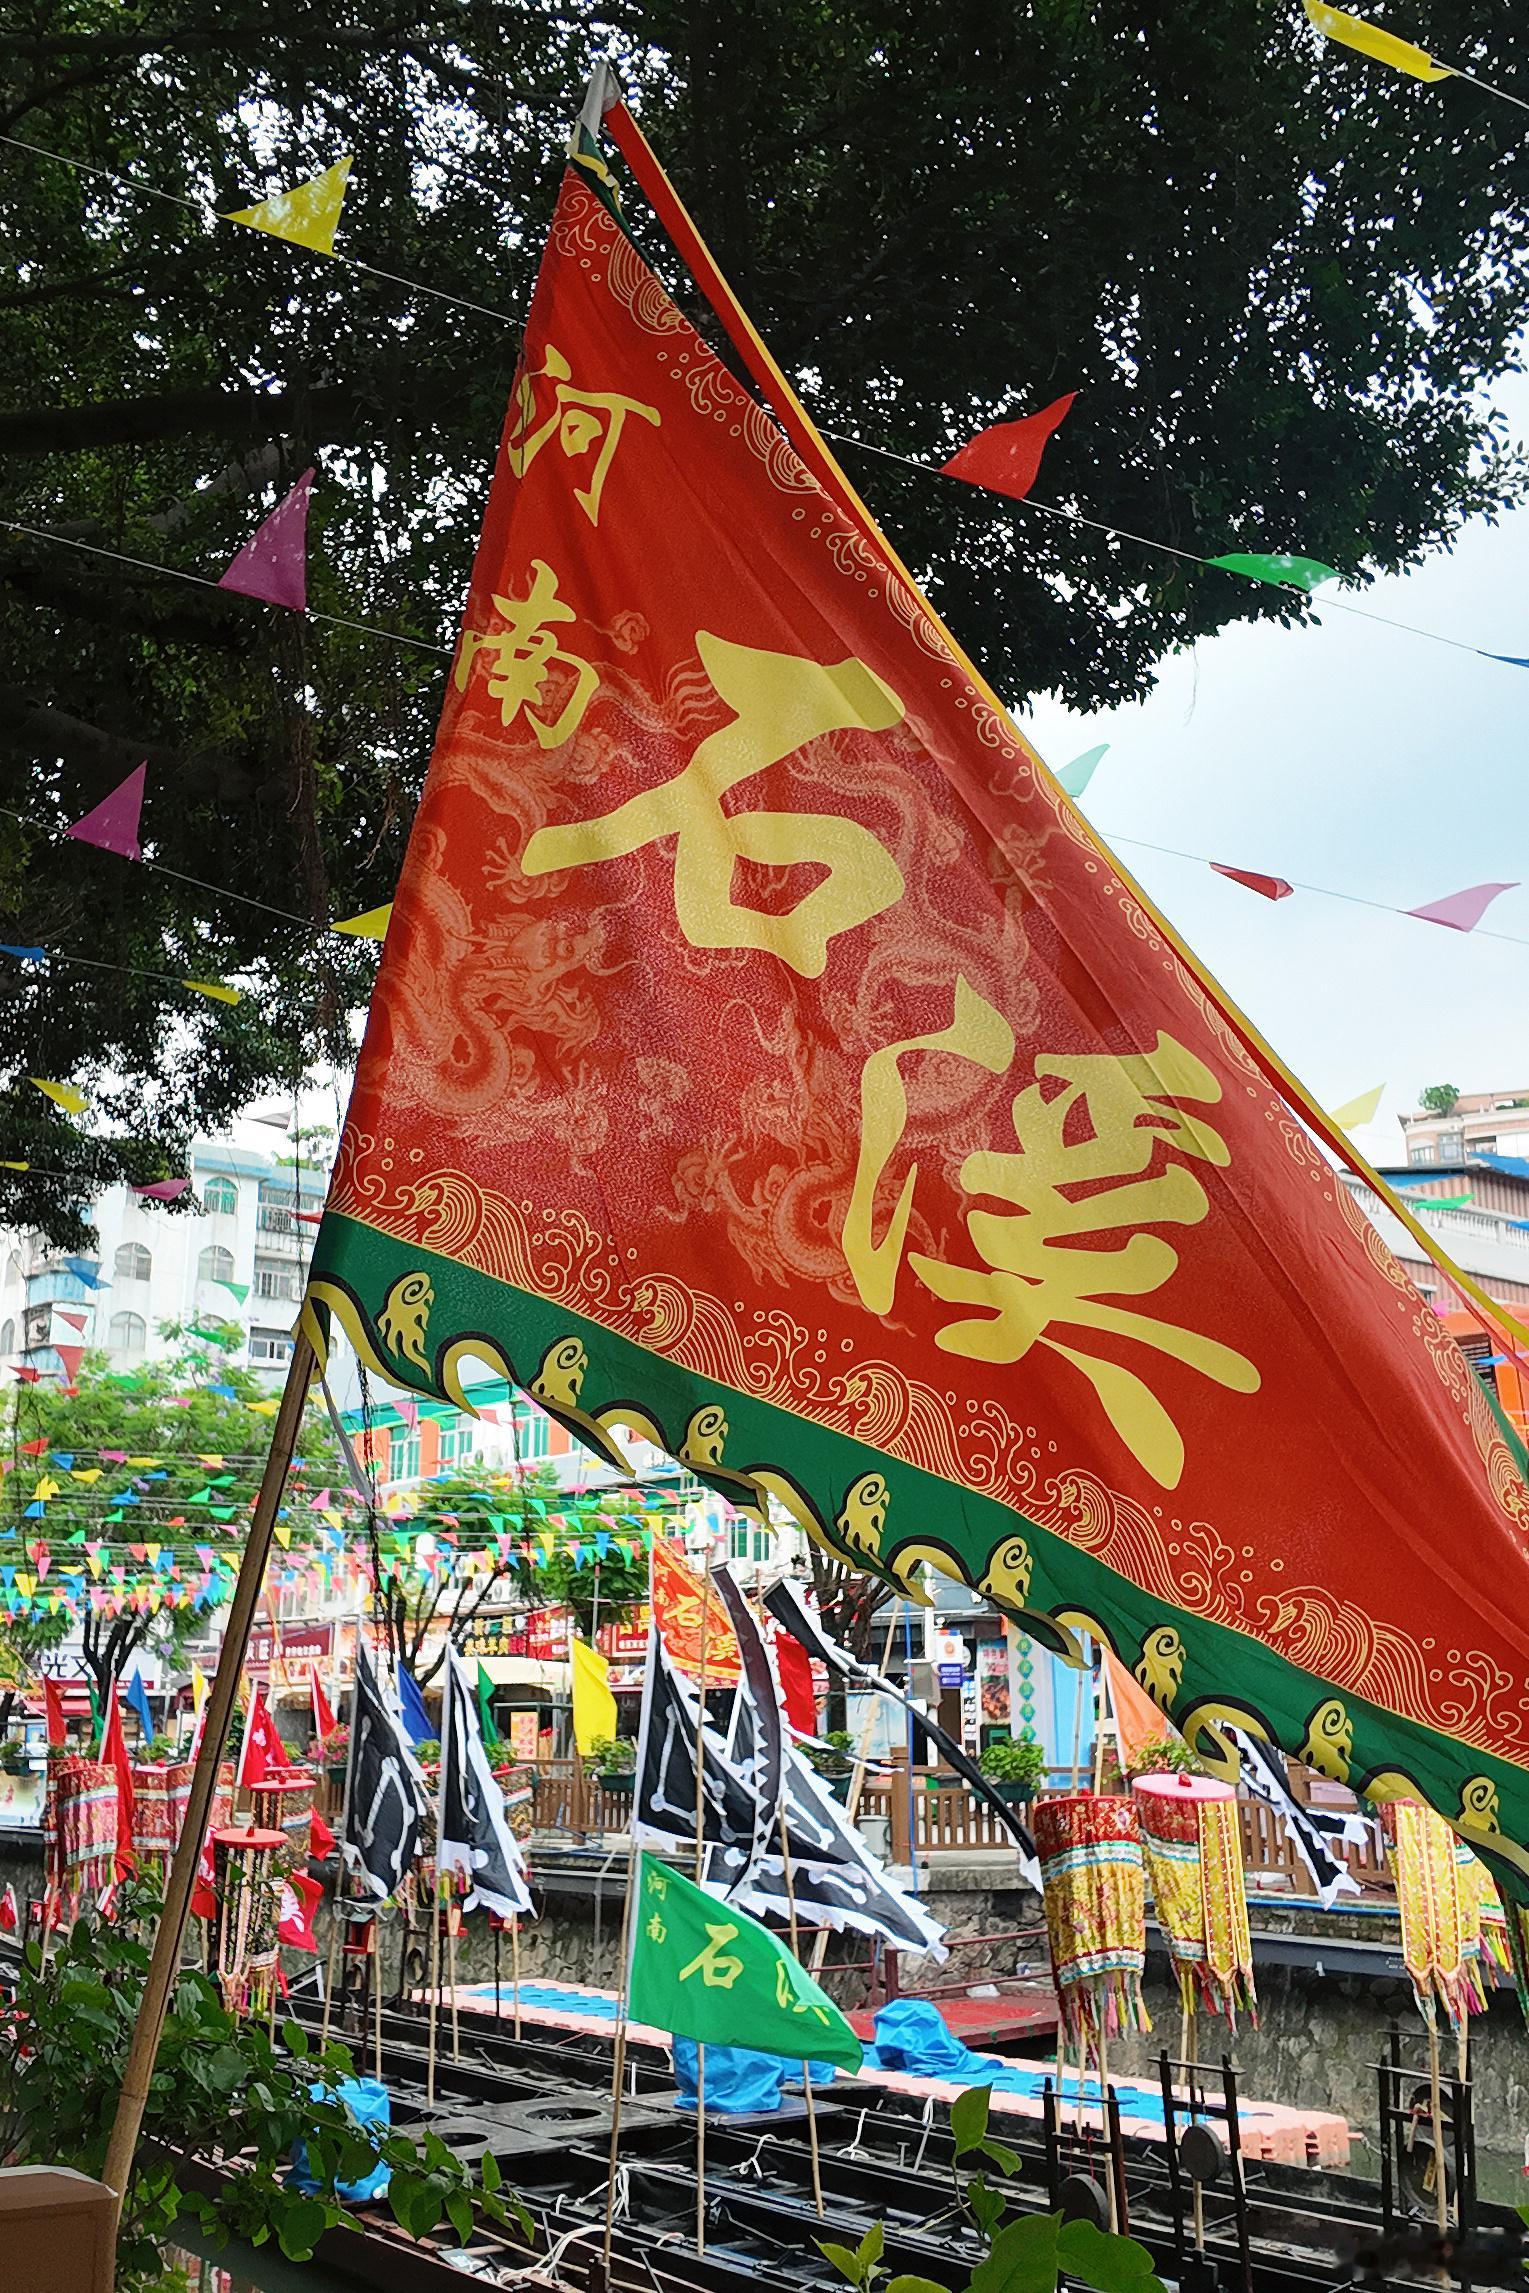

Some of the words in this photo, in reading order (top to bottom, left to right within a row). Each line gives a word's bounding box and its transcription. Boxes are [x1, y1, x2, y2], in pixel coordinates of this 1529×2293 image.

[455, 343, 662, 750] 河南
[520, 630, 1261, 1490] 石溪
[645, 1870, 672, 1945] 河南
